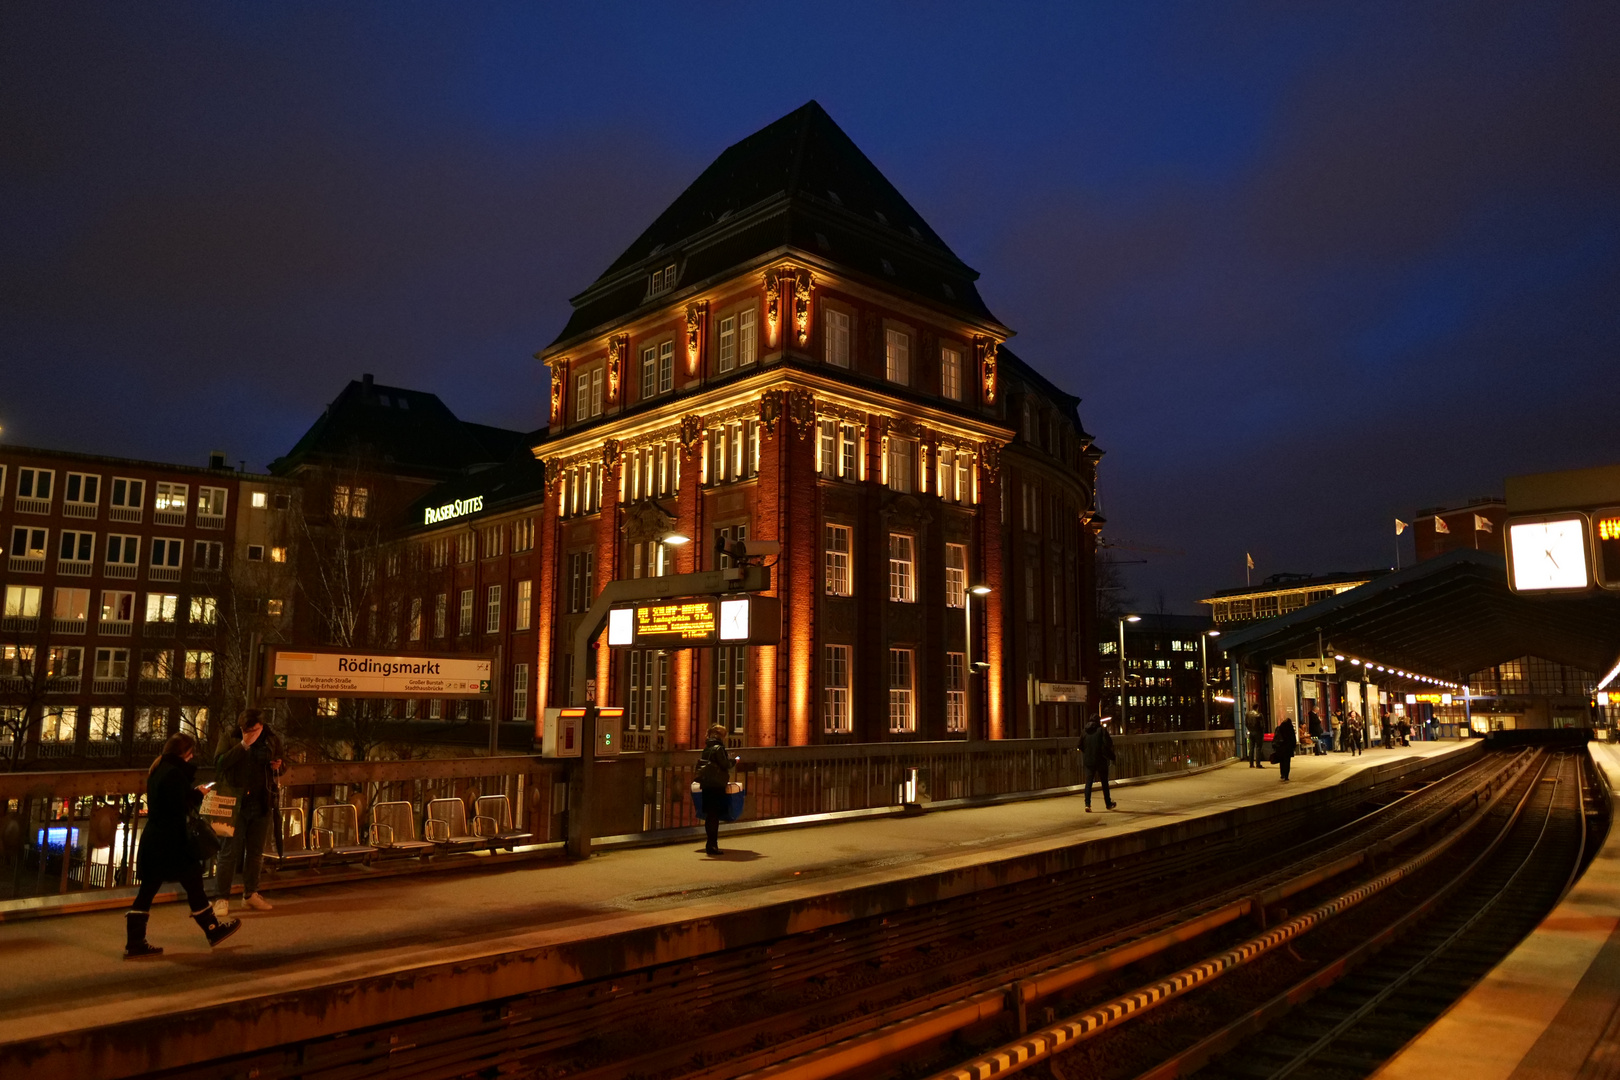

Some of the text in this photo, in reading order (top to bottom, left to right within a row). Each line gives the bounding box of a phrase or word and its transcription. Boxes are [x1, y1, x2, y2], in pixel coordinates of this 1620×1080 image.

[338, 658, 440, 677] Rödingsmarkt
[300, 683, 357, 691] Ludwig-Erhard-Straße
[405, 684, 444, 692] Stadthausbrücke
